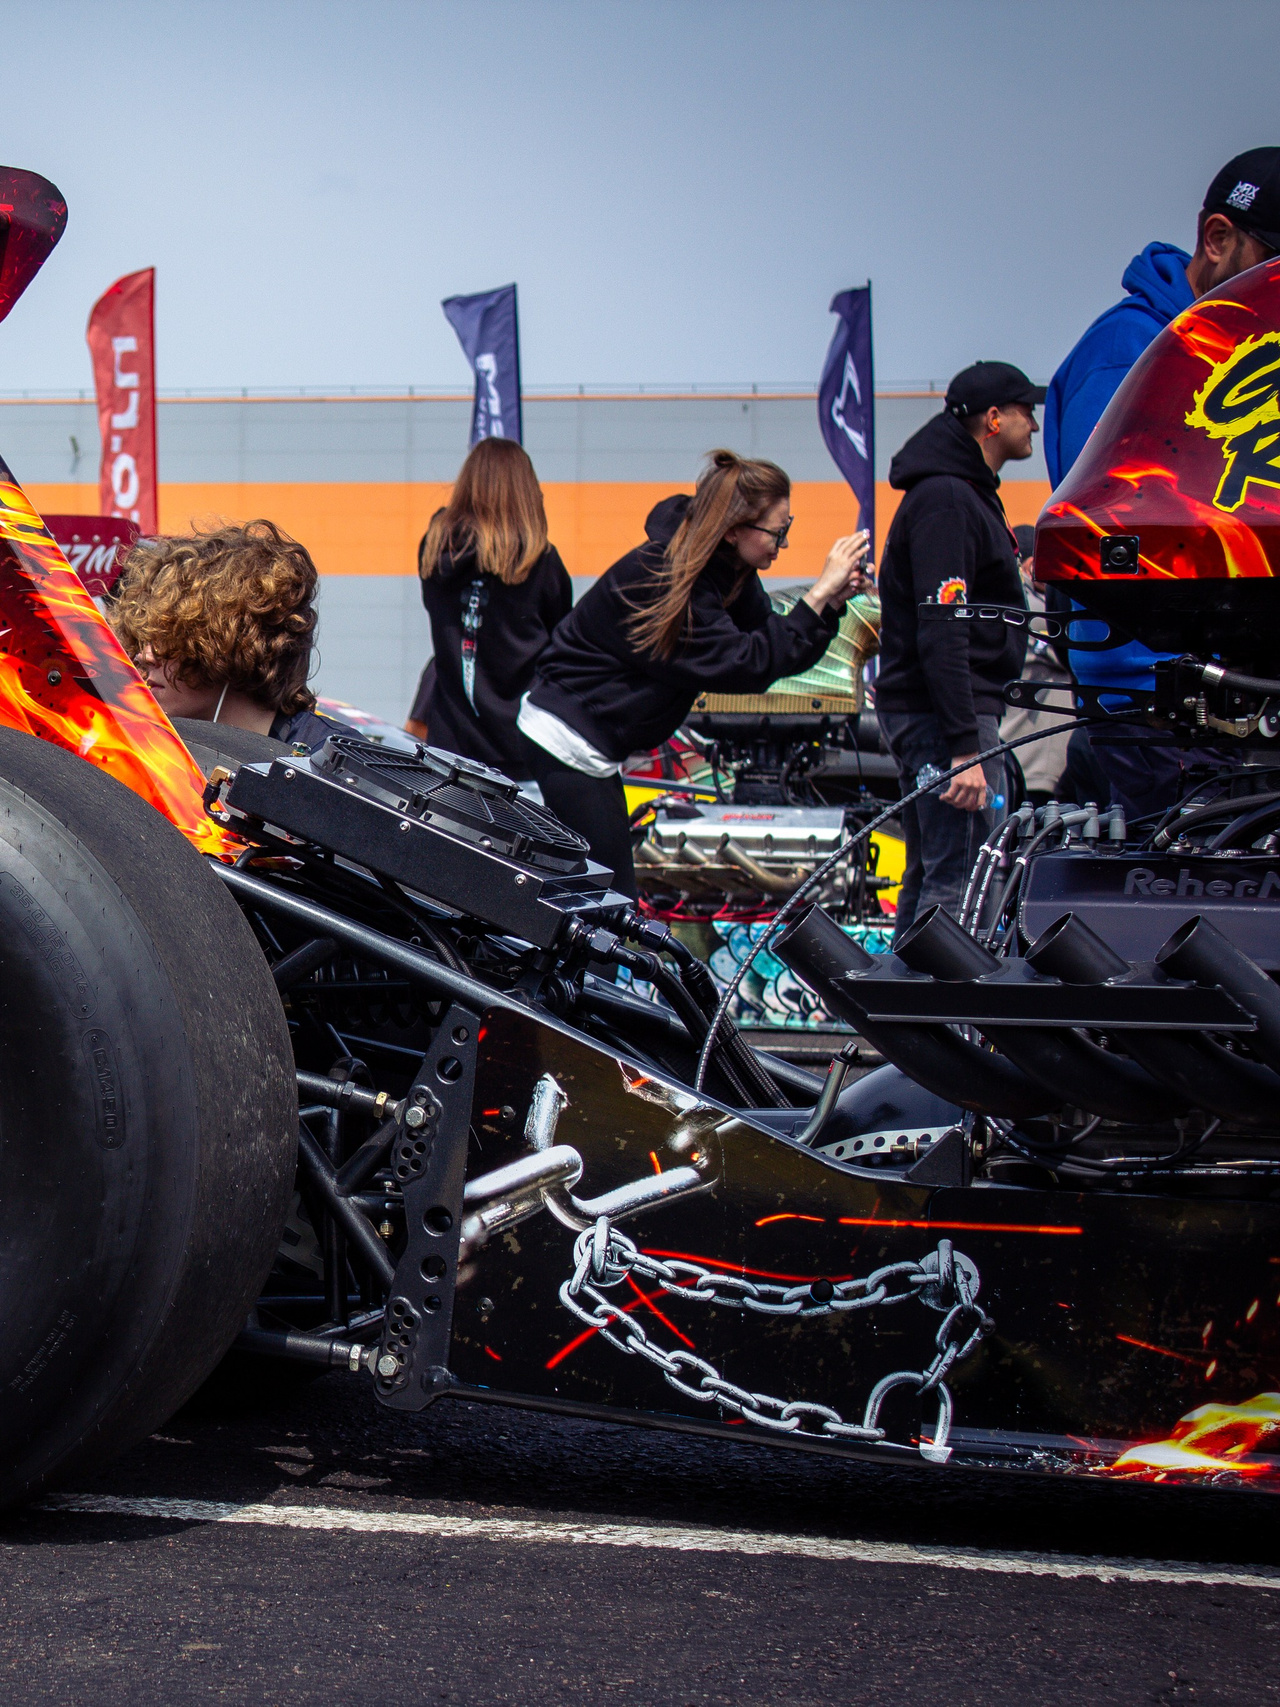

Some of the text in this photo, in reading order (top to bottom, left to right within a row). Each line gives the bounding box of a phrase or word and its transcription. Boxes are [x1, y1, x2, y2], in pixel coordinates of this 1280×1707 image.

[1232, 180, 1260, 198] MAX
[21, 916, 63, 974] DRAG
[93, 1047, 118, 1130] C1450
